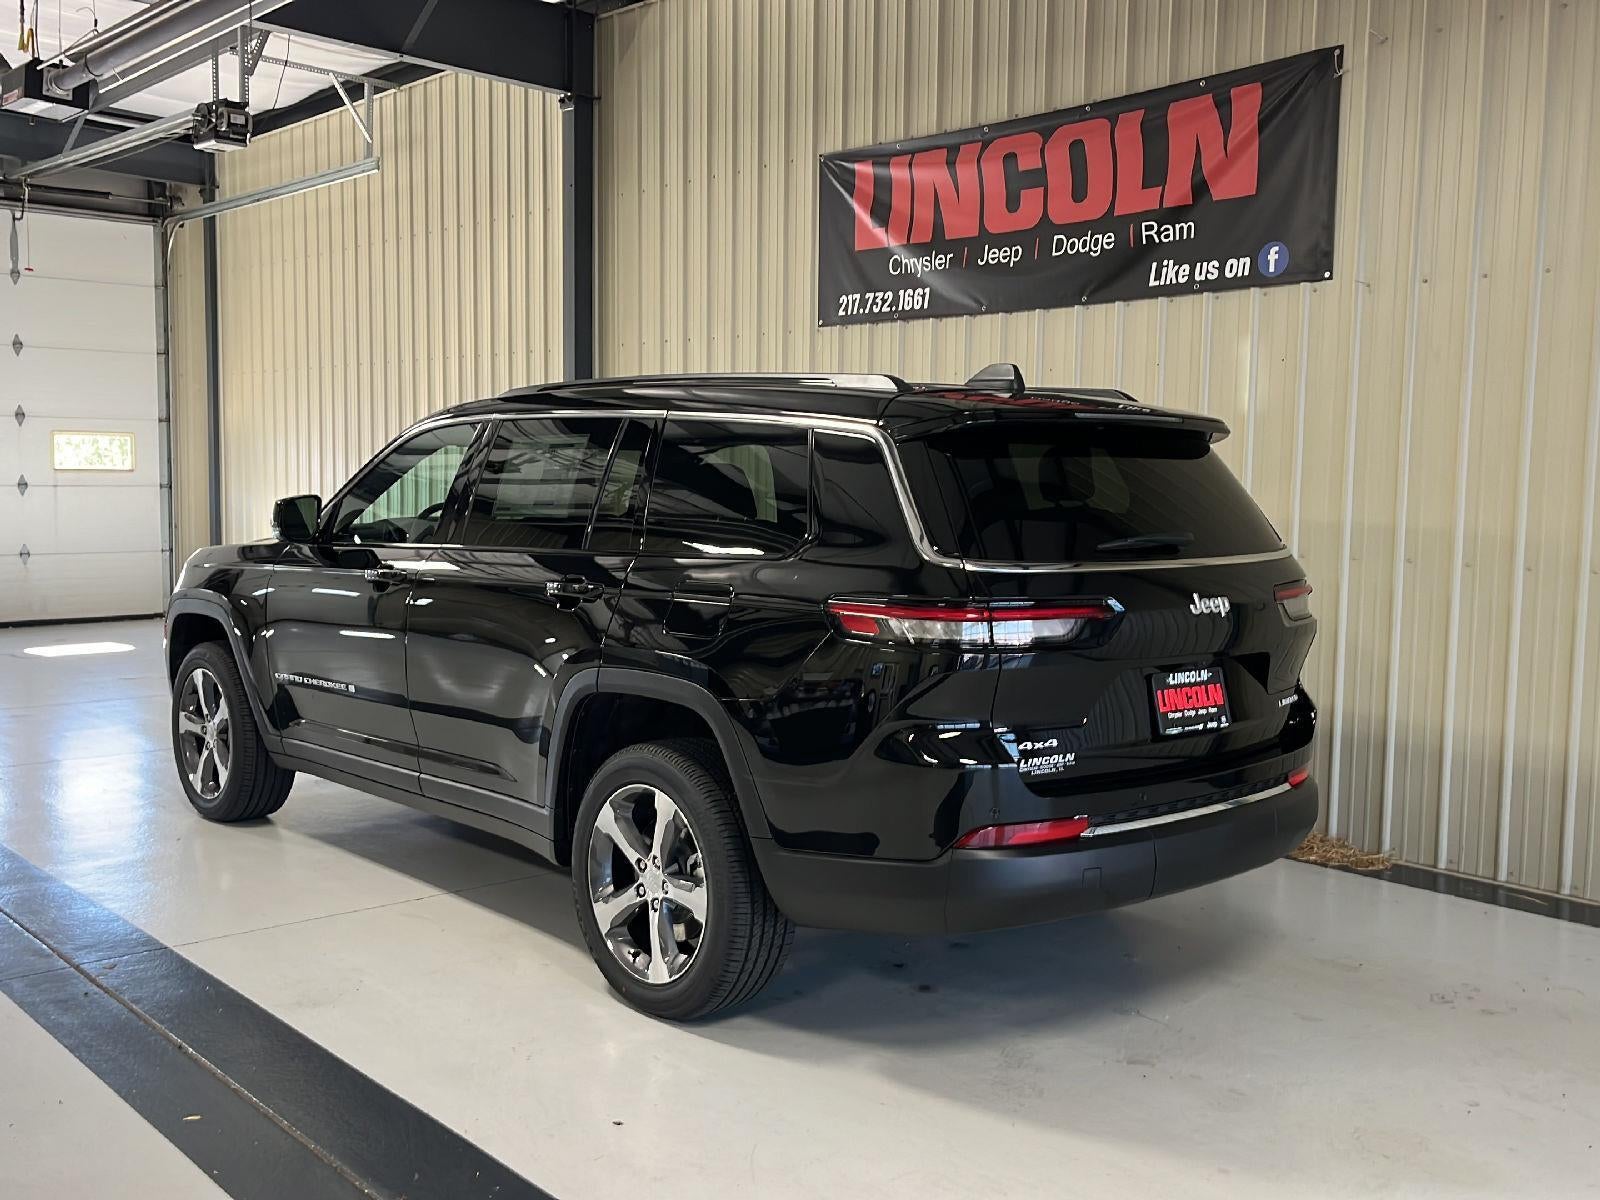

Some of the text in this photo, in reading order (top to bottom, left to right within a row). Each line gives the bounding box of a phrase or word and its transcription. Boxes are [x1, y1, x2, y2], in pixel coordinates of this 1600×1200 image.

[854, 82, 1262, 251] LINCOLN
[888, 221, 1195, 277] Chrysler Jeep Dodge Ram
[1148, 259, 1190, 287] Like
[1194, 259, 1219, 281] us
[1224, 256, 1251, 277] on
[838, 287, 931, 317] 217.732.1661
[1189, 592, 1231, 618] Jeep
[303, 677, 348, 691] CHEROKEE
[1168, 669, 1208, 685] LINCOLN
[1157, 683, 1224, 713] LINCOLN
[1018, 738, 1058, 750] 4x4
[1019, 752, 1075, 768] LINCOLN
